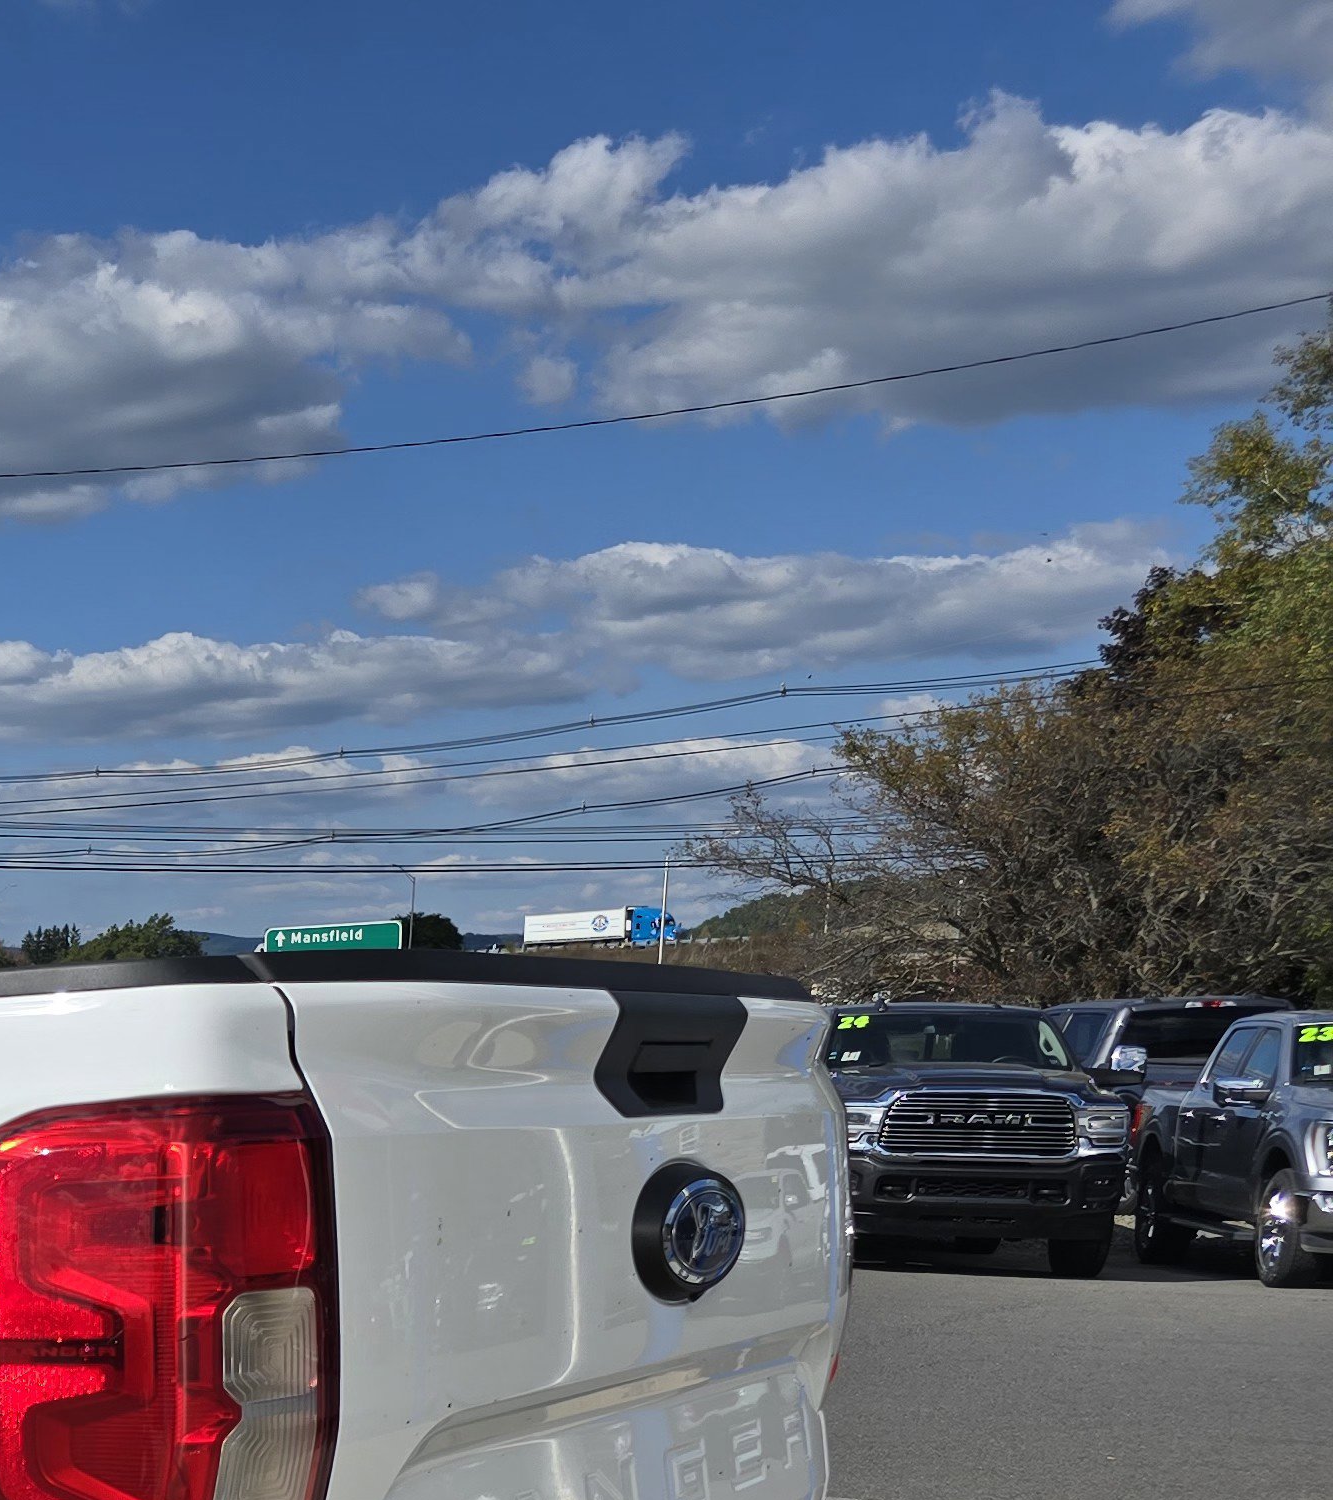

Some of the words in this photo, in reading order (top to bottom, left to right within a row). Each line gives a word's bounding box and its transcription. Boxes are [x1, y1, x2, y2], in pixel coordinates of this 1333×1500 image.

[290, 928, 363, 944] Mansfield
[837, 1015, 870, 1030] 24
[1298, 1026, 1333, 1042] 23
